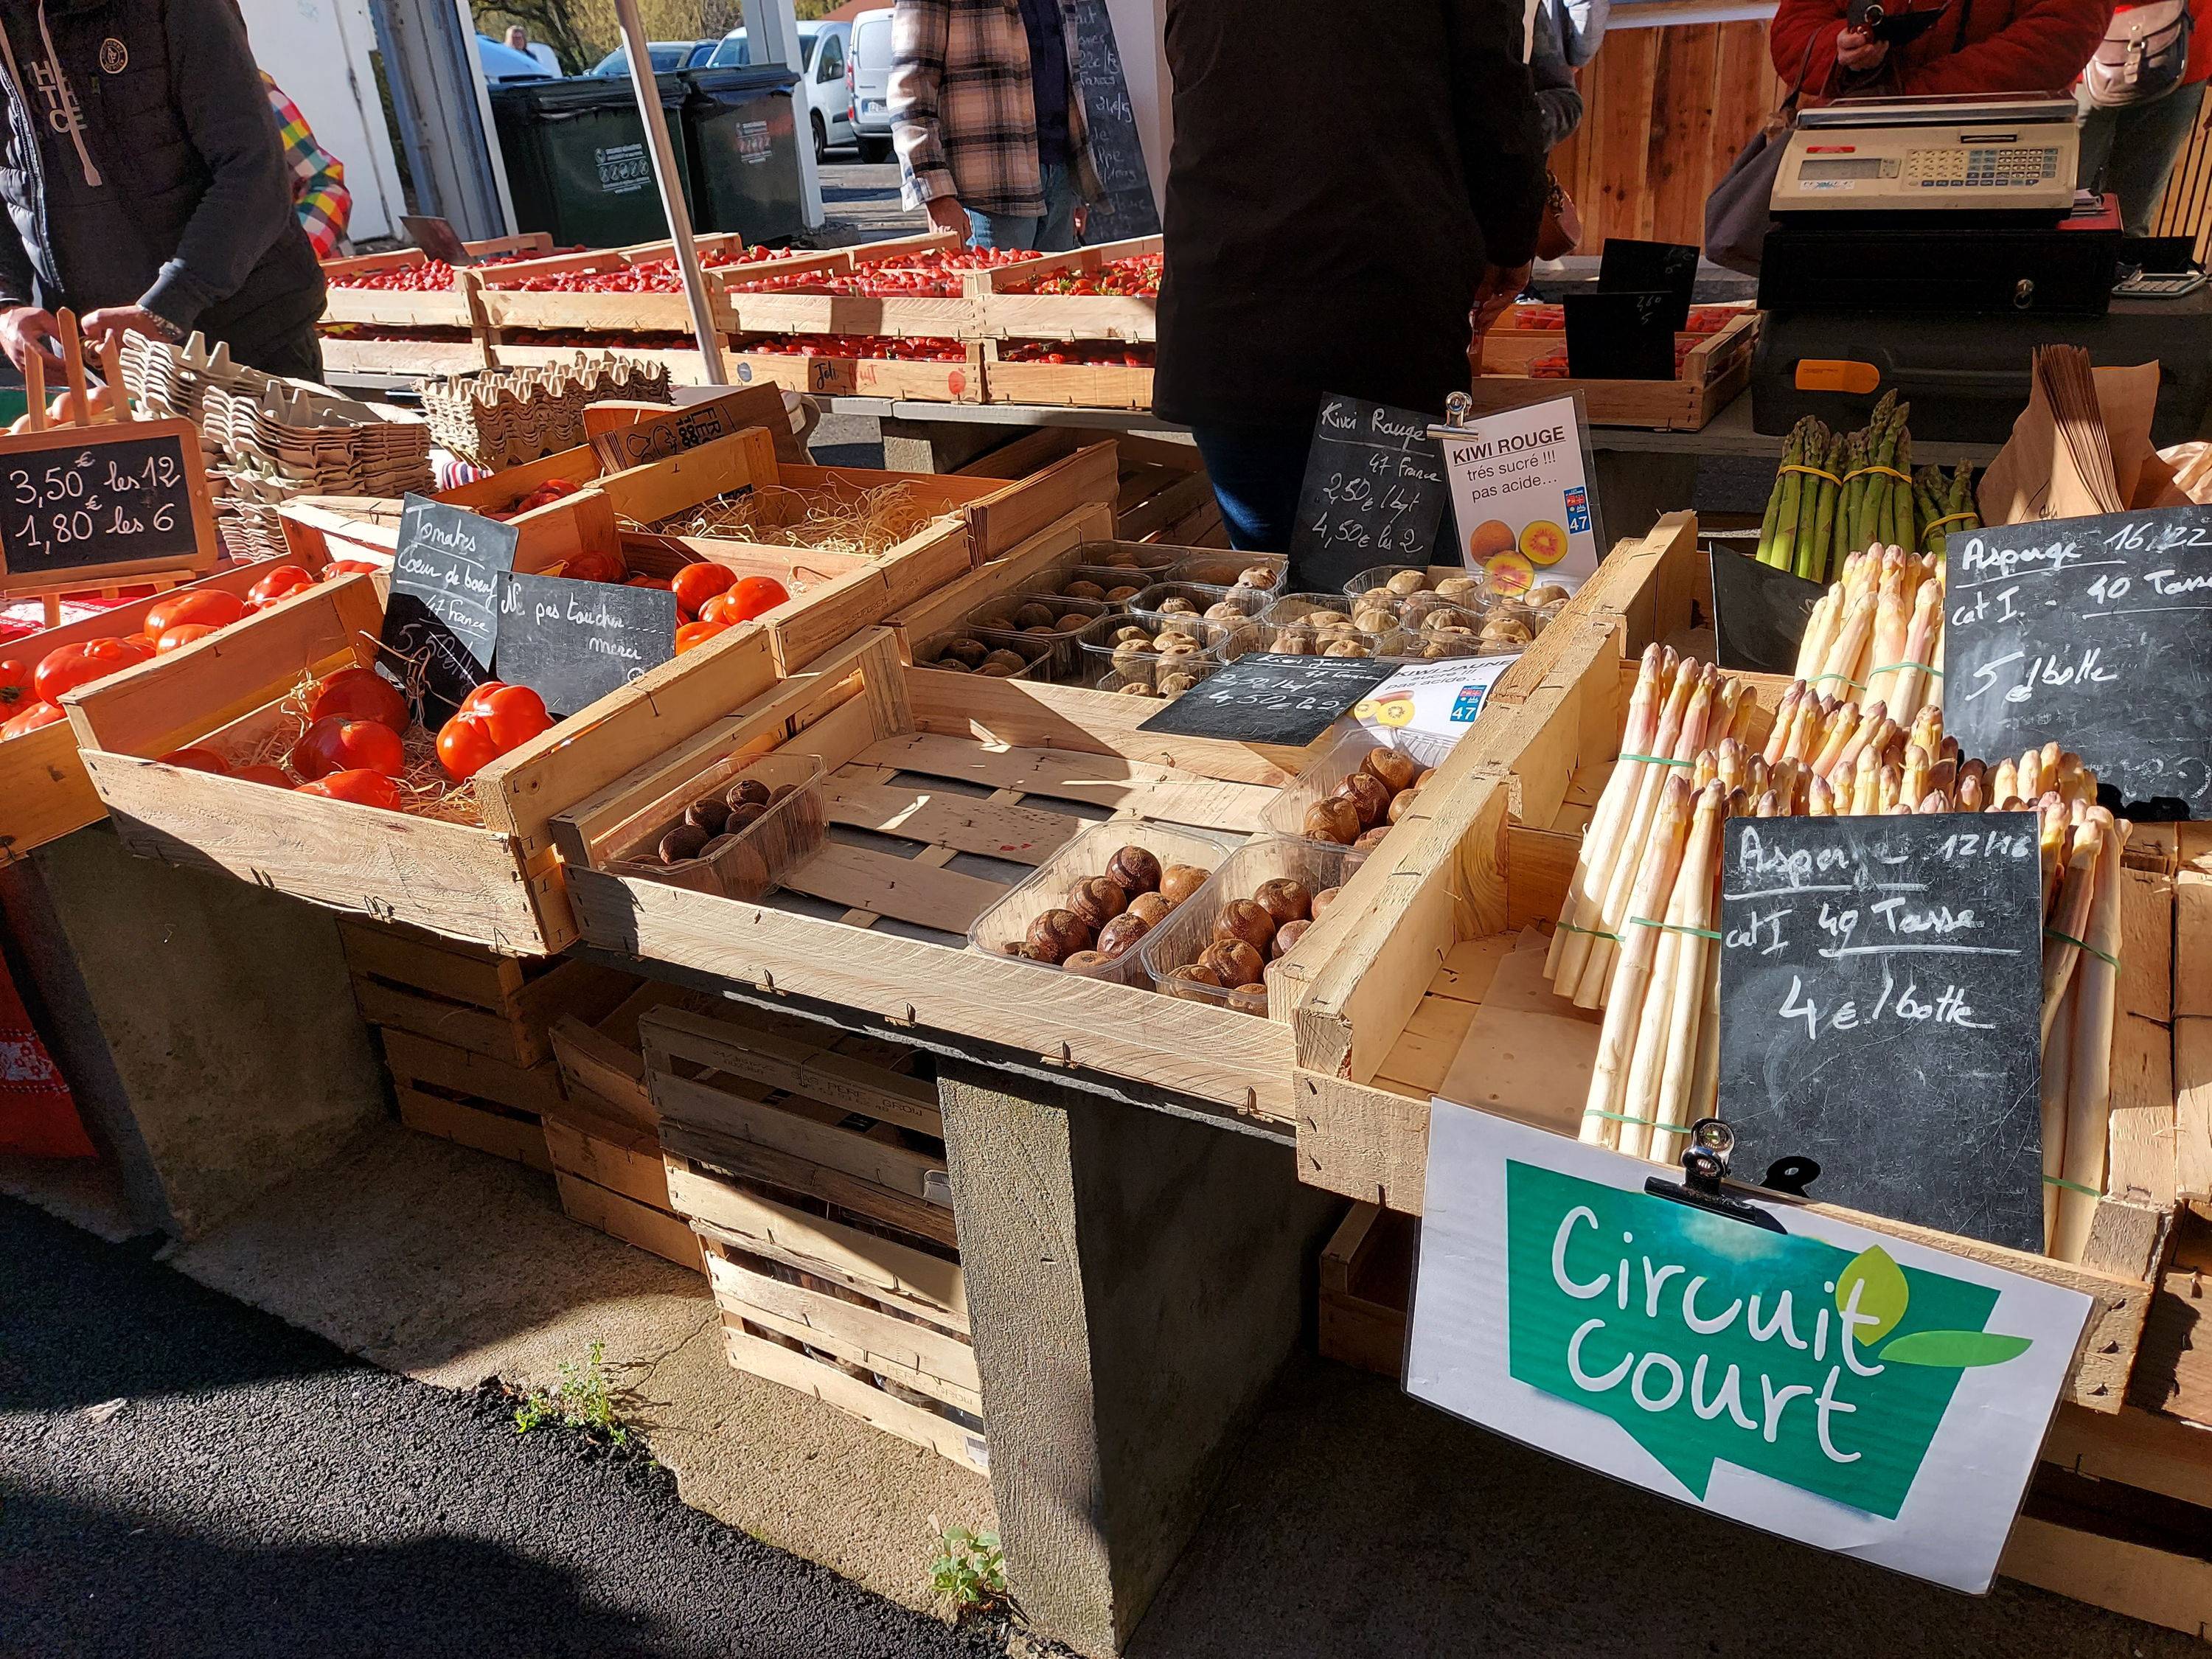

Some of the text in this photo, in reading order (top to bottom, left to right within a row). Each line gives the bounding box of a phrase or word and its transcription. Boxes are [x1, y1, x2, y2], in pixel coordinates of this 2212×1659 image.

[1371, 408, 1426, 452] Rouge
[1453, 425, 1565, 464] KIWI ROUGE
[103, 461, 140, 492] les
[141, 456, 181, 487] 12
[1368, 453, 1442, 482] 47 France
[1467, 450, 1556, 481] trés sucré !!!
[1472, 485, 1498, 503] pas
[105, 506, 144, 535] les
[153, 503, 175, 531] 6
[406, 503, 476, 552] Tomates
[1569, 515, 1587, 531] 47
[1377, 524, 1394, 550] les
[1399, 529, 1424, 553] 2
[444, 564, 460, 586] de
[2086, 574, 2132, 605] 40
[448, 599, 490, 633] France
[535, 602, 560, 626] pas
[1385, 681, 1416, 691] pas
[1394, 667, 1439, 678] KIWI
[1452, 706, 1477, 720] 47
[1551, 1205, 1885, 1377] Circuit
[1567, 1318, 1863, 1465] Court
